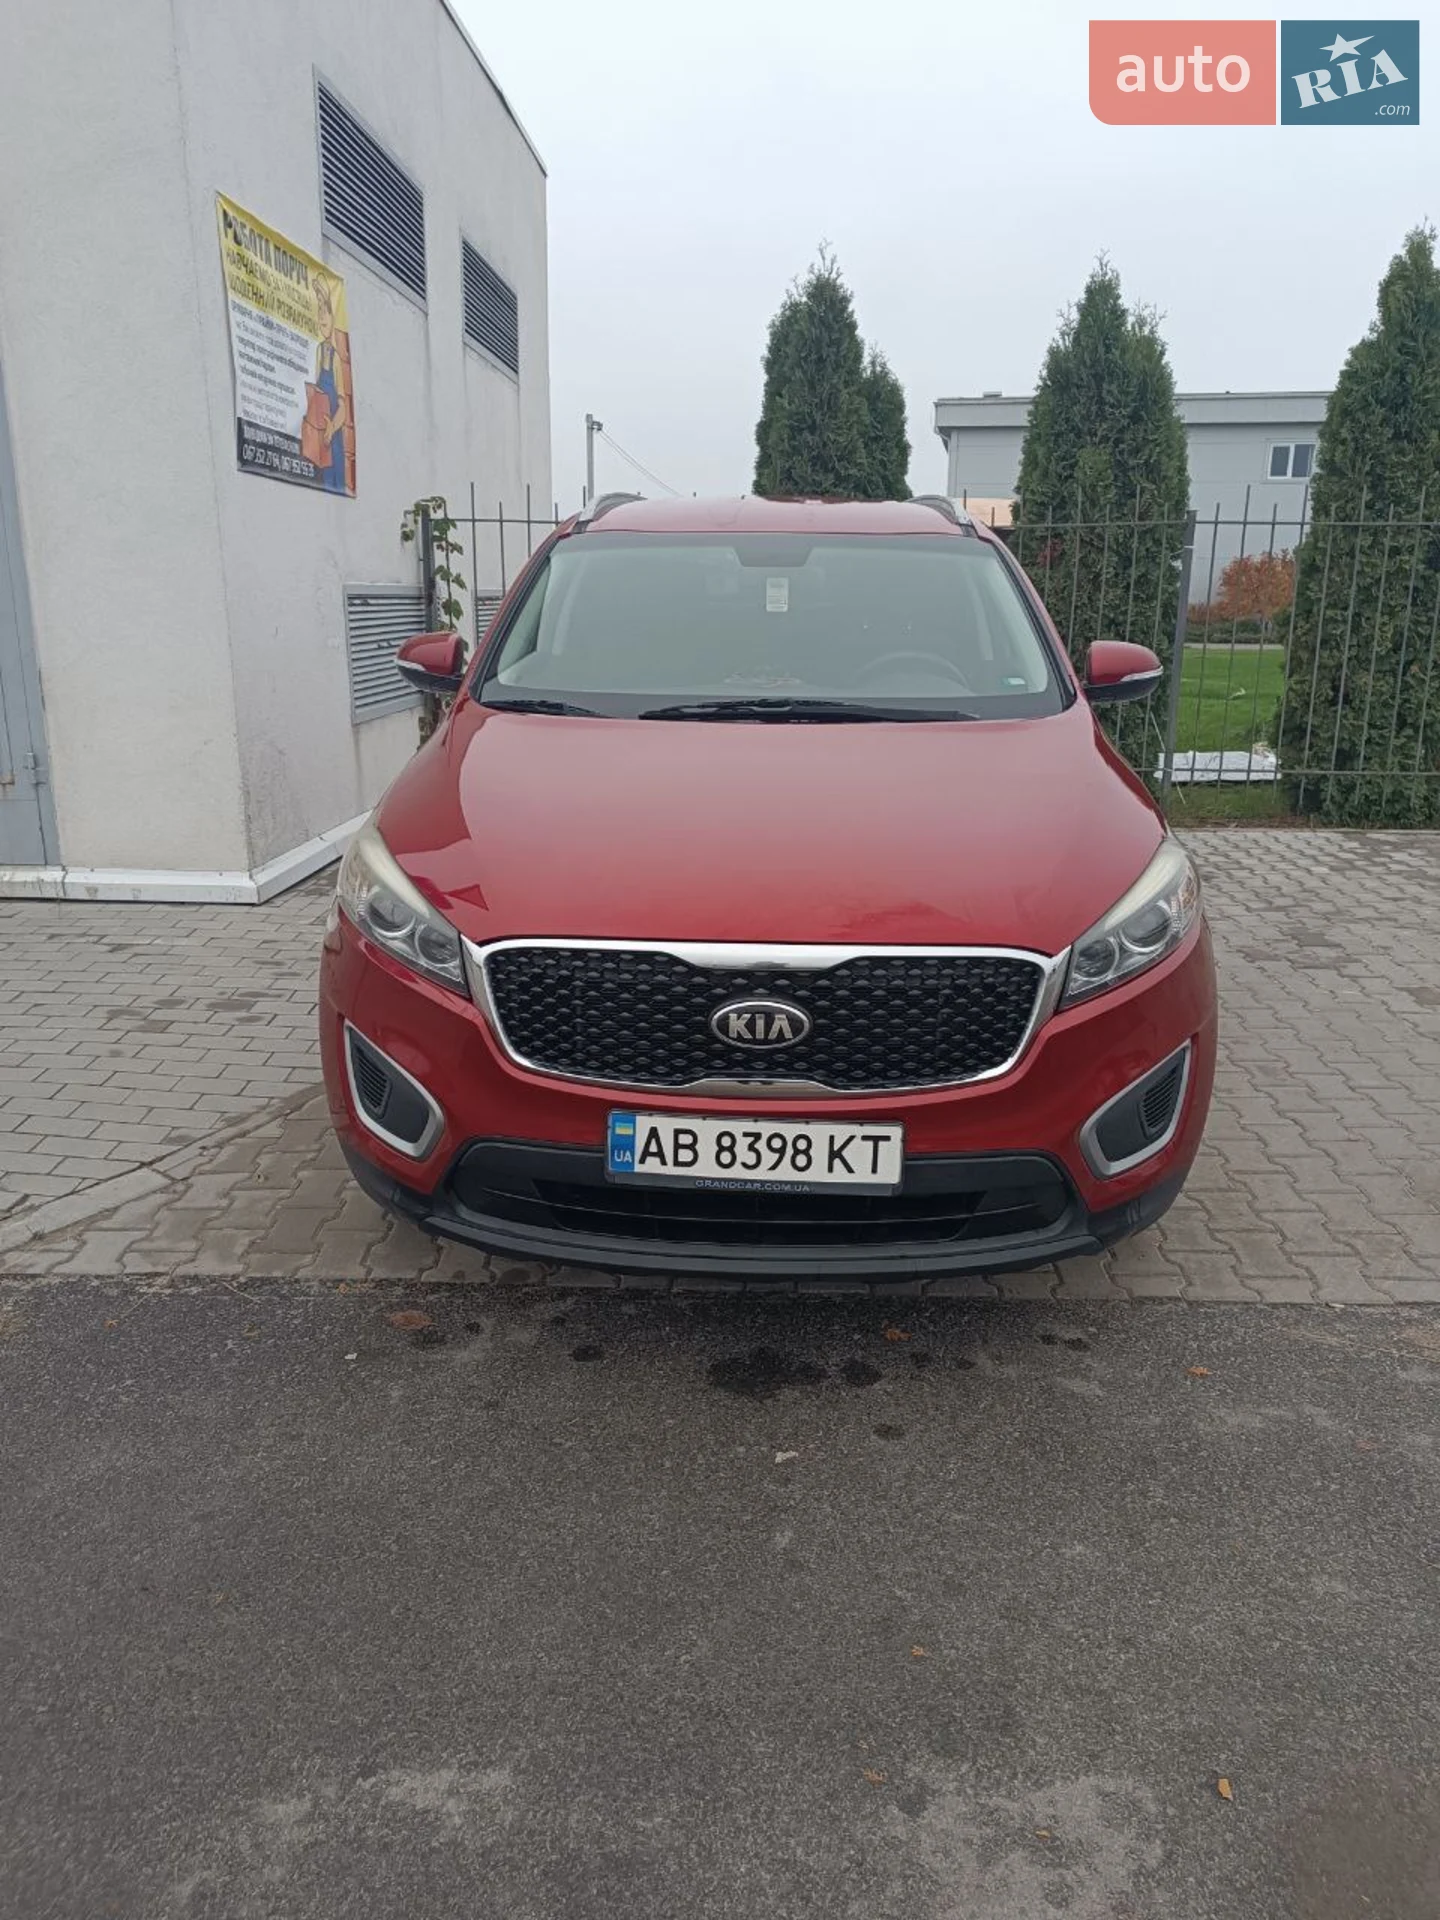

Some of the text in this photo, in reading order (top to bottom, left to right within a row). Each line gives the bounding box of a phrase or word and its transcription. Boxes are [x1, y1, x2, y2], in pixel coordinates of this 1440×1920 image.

[728, 1013, 794, 1039] KIA
[614, 1149, 632, 1162] UA
[638, 1126, 892, 1174] AB 8398 KT
[695, 1180, 810, 1192] GRANDCAR.COM.UA
